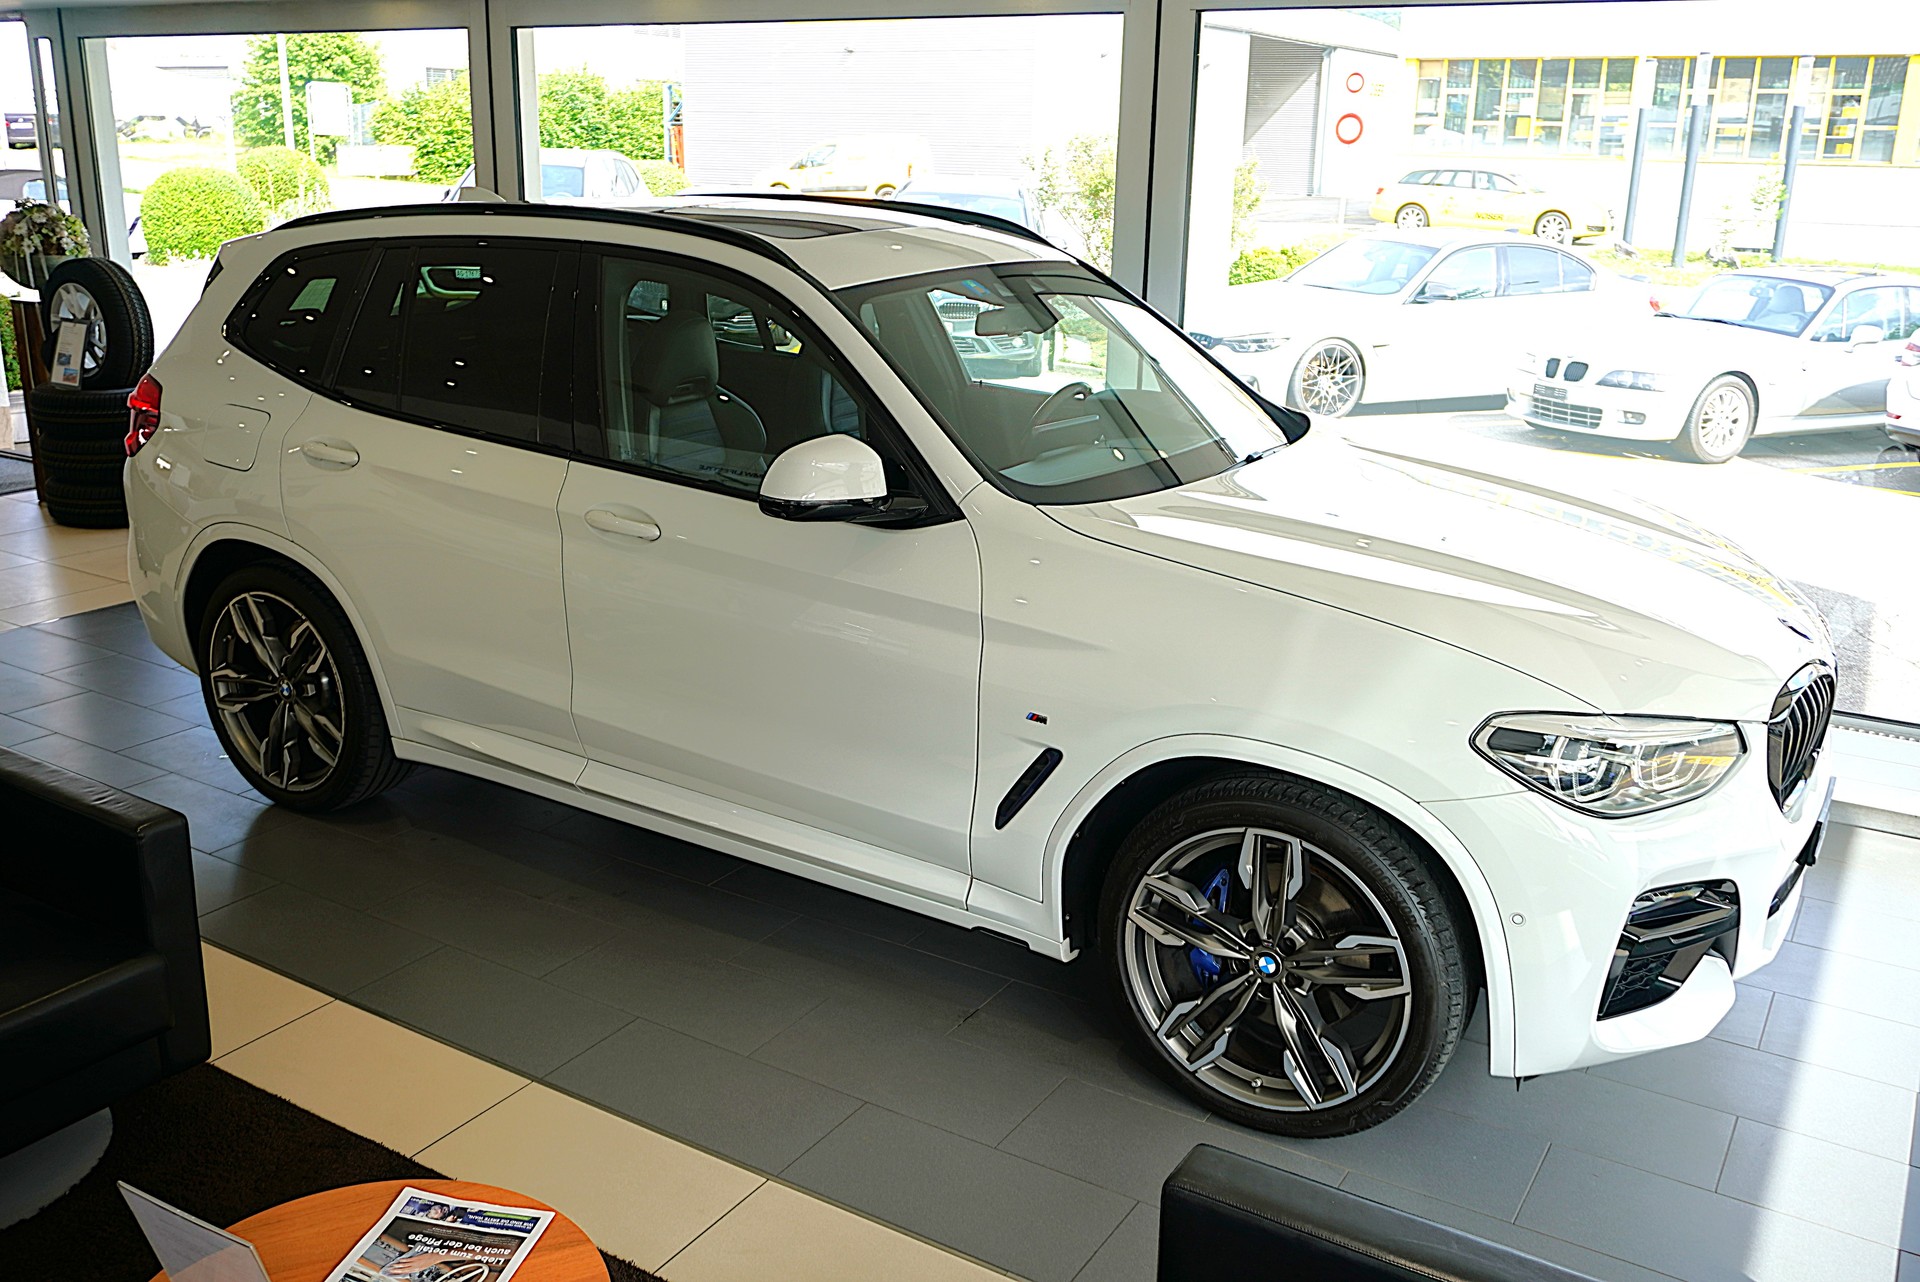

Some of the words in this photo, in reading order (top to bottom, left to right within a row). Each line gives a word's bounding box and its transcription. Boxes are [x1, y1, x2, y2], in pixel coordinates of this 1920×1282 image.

[408, 1234, 442, 1246] Pflege
[443, 1239, 463, 1249] der
[415, 1245, 448, 1257] Detail
[464, 1243, 482, 1252] bei
[484, 1246, 511, 1256] auch
[449, 1250, 474, 1260] zum
[475, 1254, 505, 1266] Liebe
